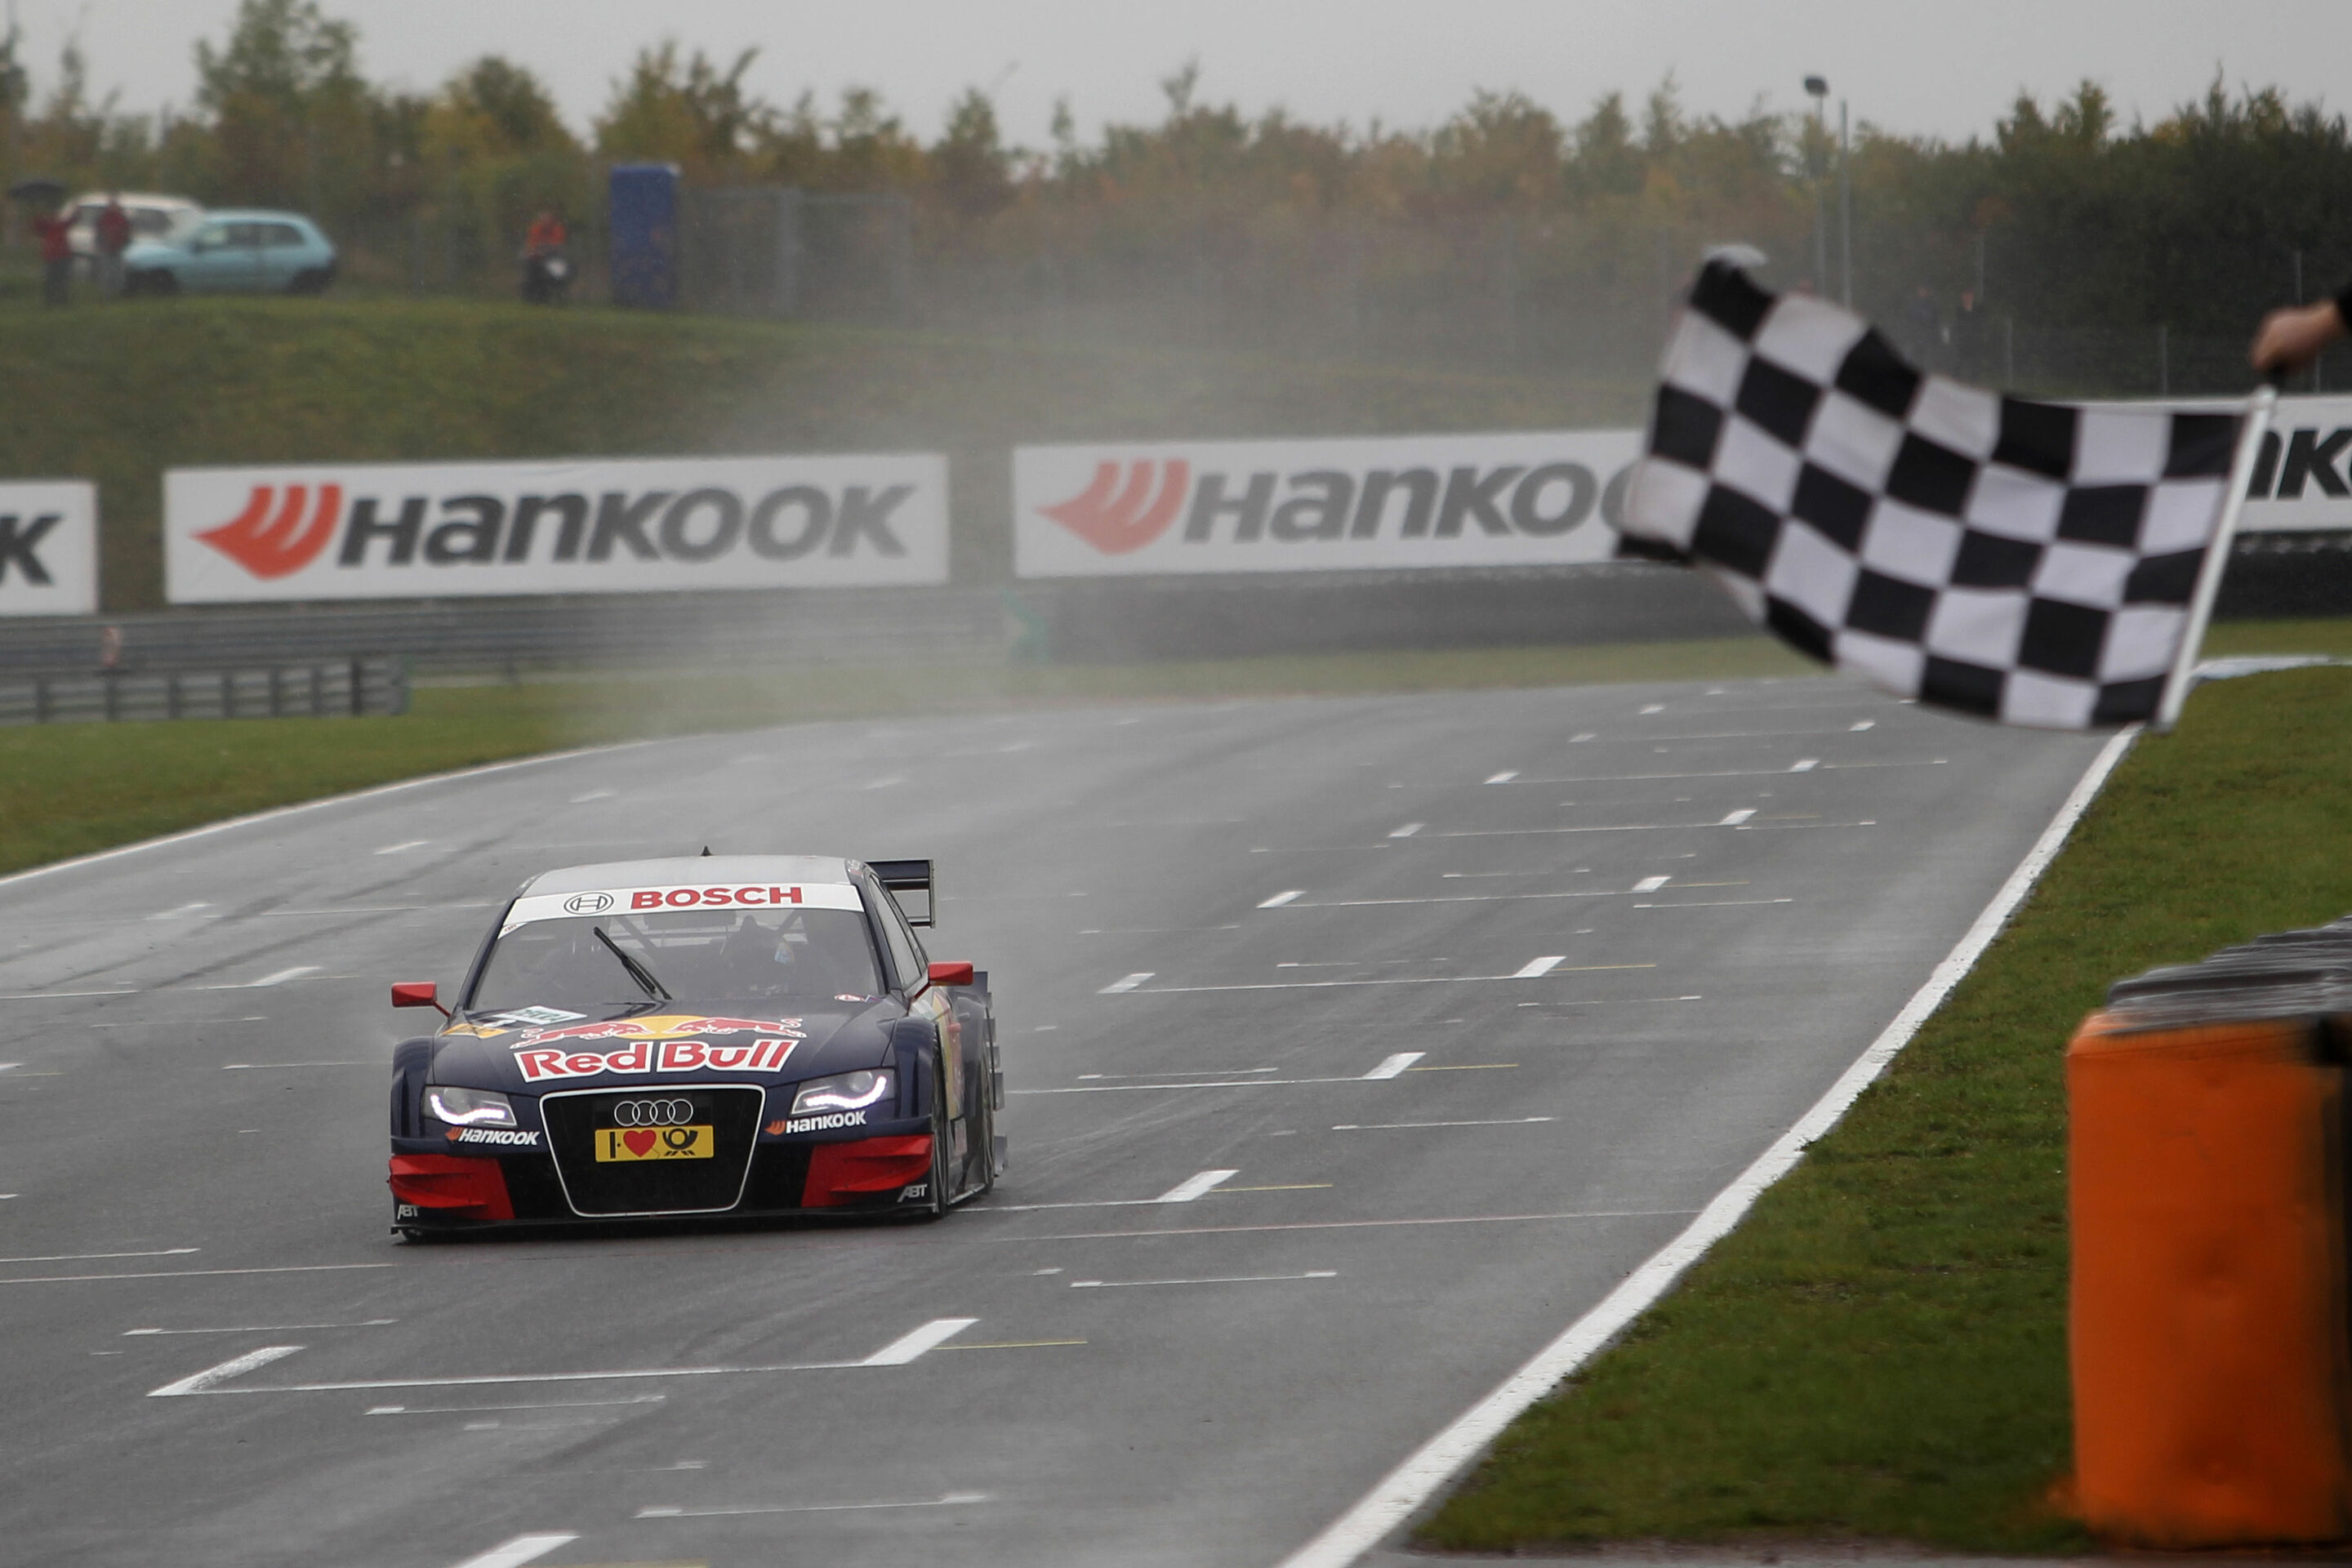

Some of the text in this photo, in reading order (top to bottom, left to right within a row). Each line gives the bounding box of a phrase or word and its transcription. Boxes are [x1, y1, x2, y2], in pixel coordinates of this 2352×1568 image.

[630, 887, 803, 910] BOSCH
[516, 1040, 793, 1079] Red Bull
[897, 1183, 928, 1203] ABT
[397, 1204, 419, 1220] ABT
